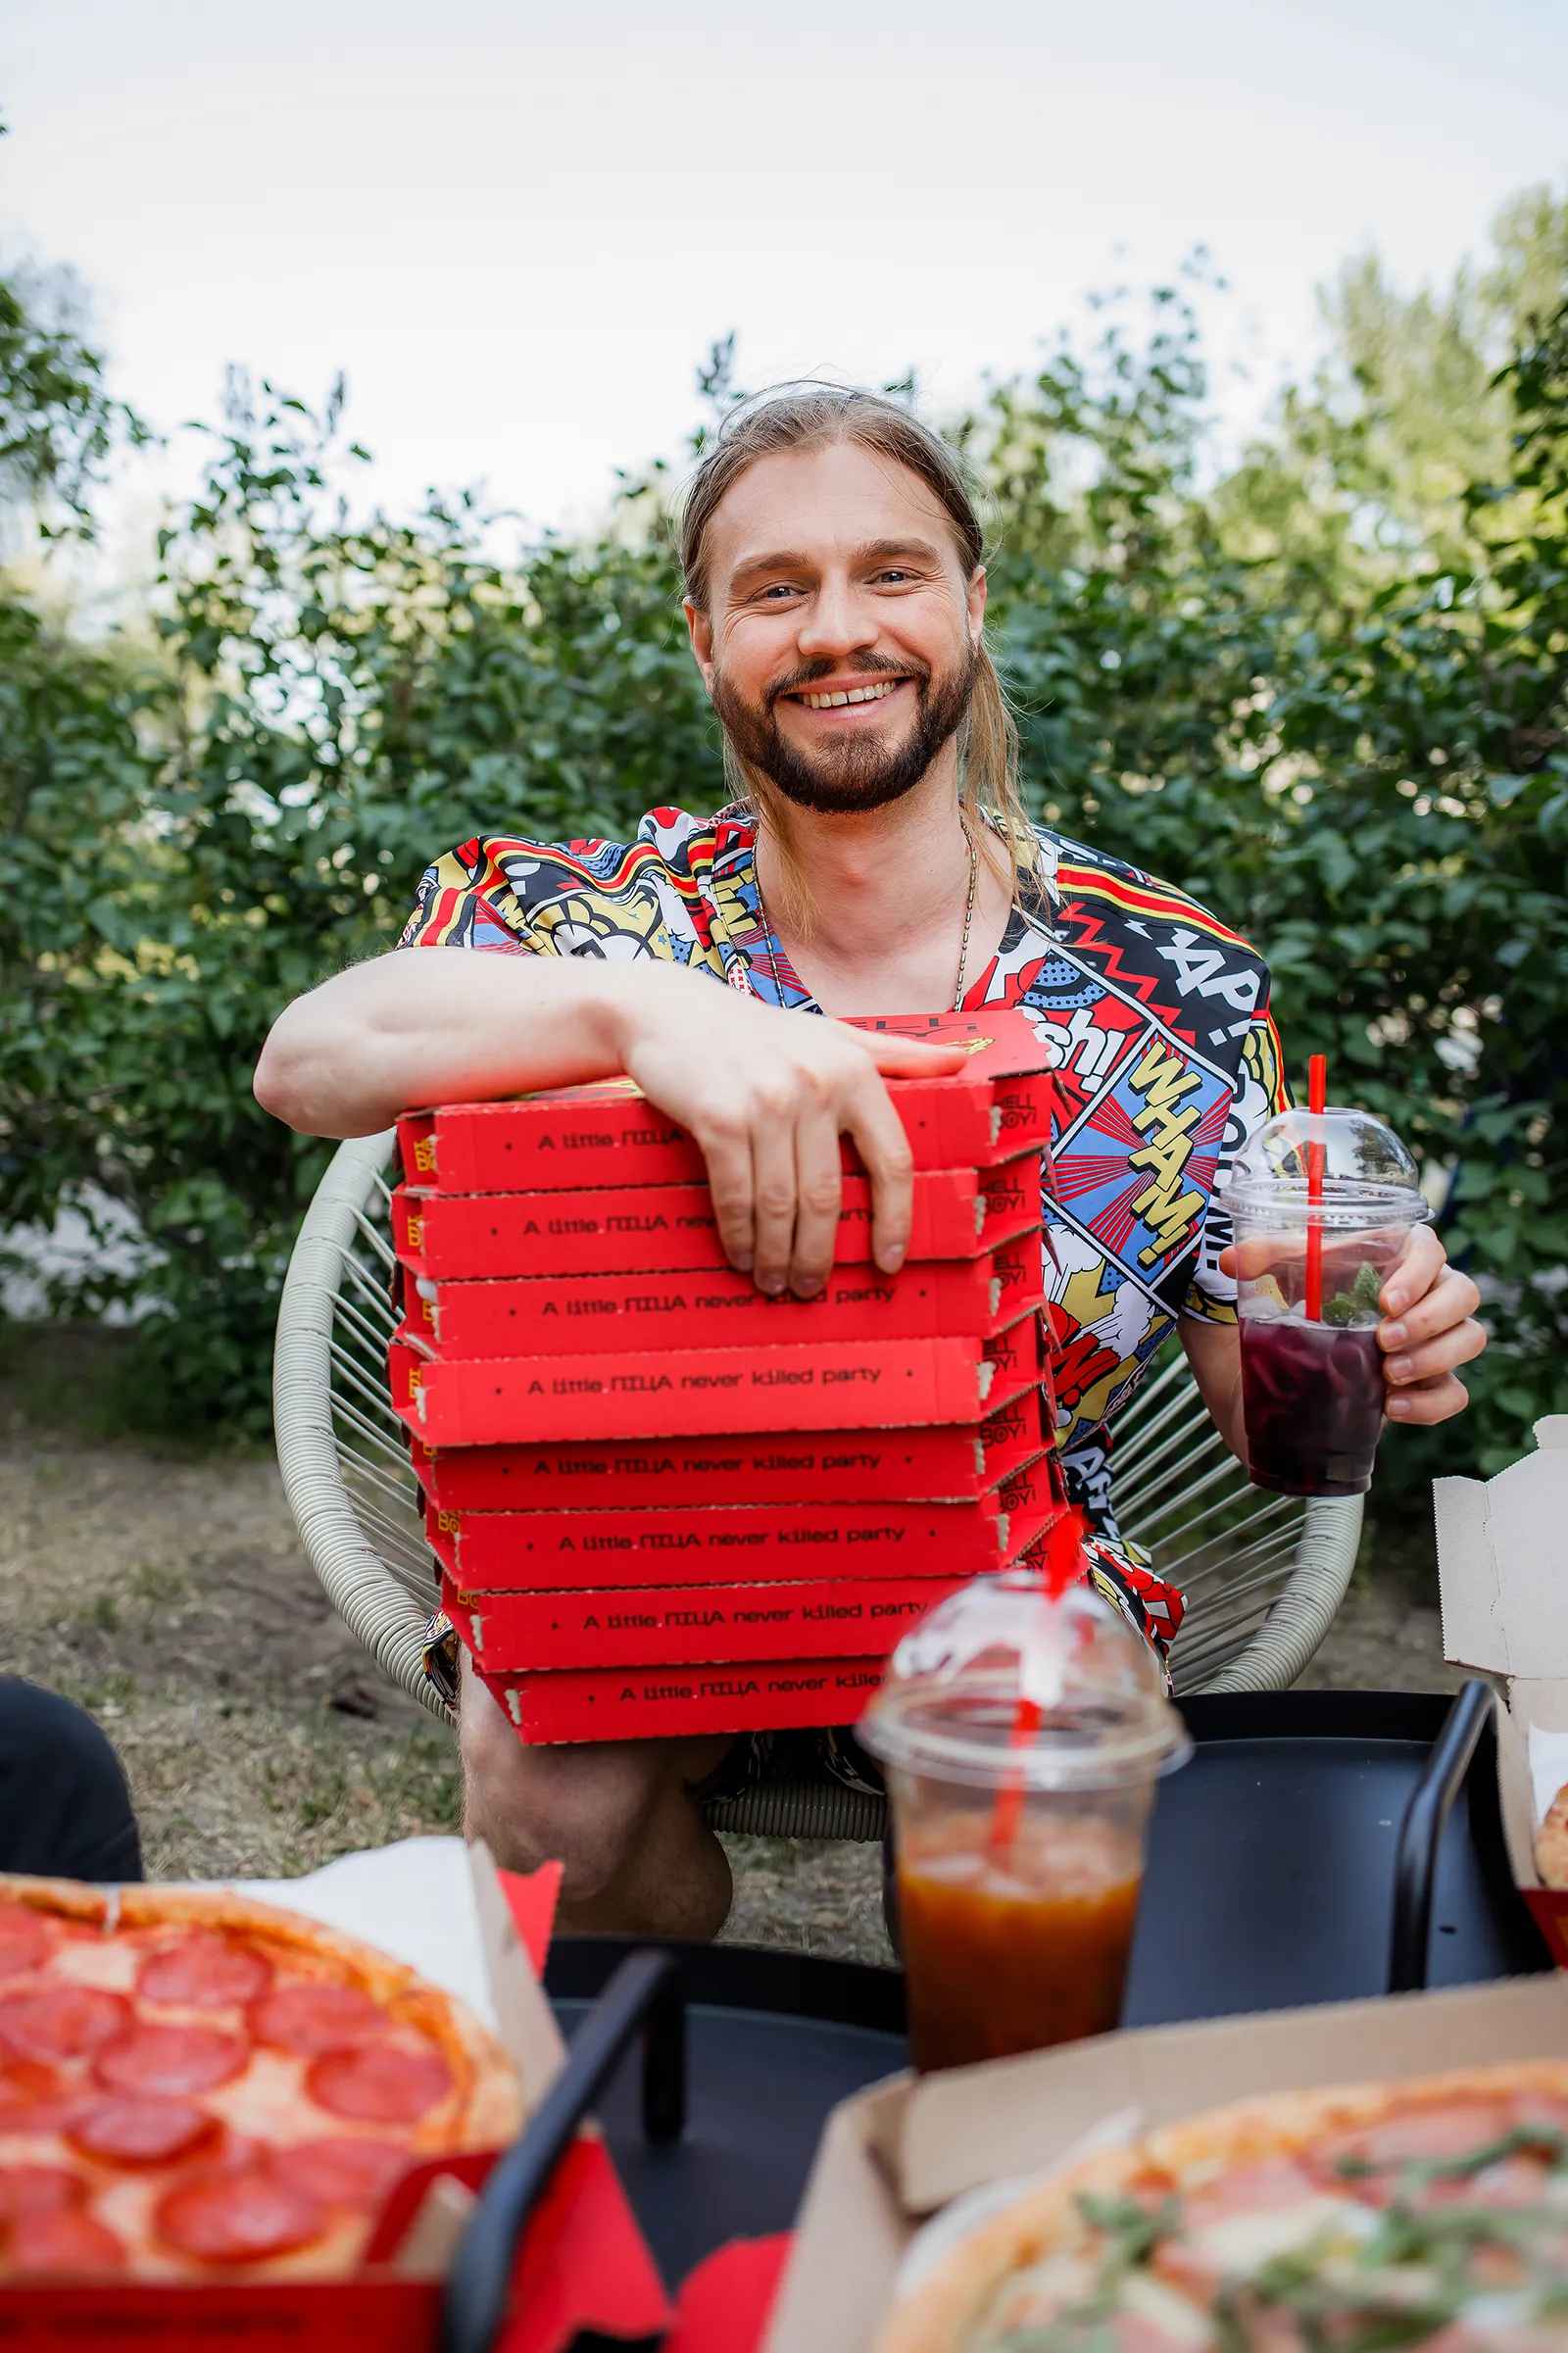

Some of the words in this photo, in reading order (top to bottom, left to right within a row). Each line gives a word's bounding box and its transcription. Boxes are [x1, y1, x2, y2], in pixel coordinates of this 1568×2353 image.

[539, 1135, 555, 1150] A
[563, 1132, 613, 1149] little
[1128, 1040, 1208, 1266] WHAM!
[524, 1219, 541, 1235] A
[548, 1218, 598, 1234] little
[994, 1252, 1025, 1270] ELL
[542, 1301, 559, 1315] A
[566, 1299, 617, 1315] little
[696, 1294, 755, 1309] never
[836, 1287, 896, 1303] party
[528, 1380, 545, 1395] A
[553, 1378, 603, 1394] little
[681, 1374, 743, 1389] never
[753, 1368, 813, 1386] killed
[822, 1366, 882, 1384] party
[534, 1460, 551, 1475] A
[558, 1459, 608, 1475] little
[683, 1457, 743, 1472] never
[753, 1453, 814, 1470] killed
[822, 1453, 880, 1470] party
[559, 1537, 574, 1550] A
[582, 1535, 631, 1550] little
[710, 1533, 768, 1546] never
[778, 1529, 839, 1544] killed
[847, 1527, 906, 1544] party
[584, 1615, 600, 1630] A
[608, 1614, 657, 1629] little
[733, 1608, 794, 1624] never
[803, 1603, 862, 1621] killed
[871, 1601, 928, 1619] party
[620, 1688, 636, 1701] A
[644, 1685, 692, 1700] little
[768, 1678, 827, 1691] never
